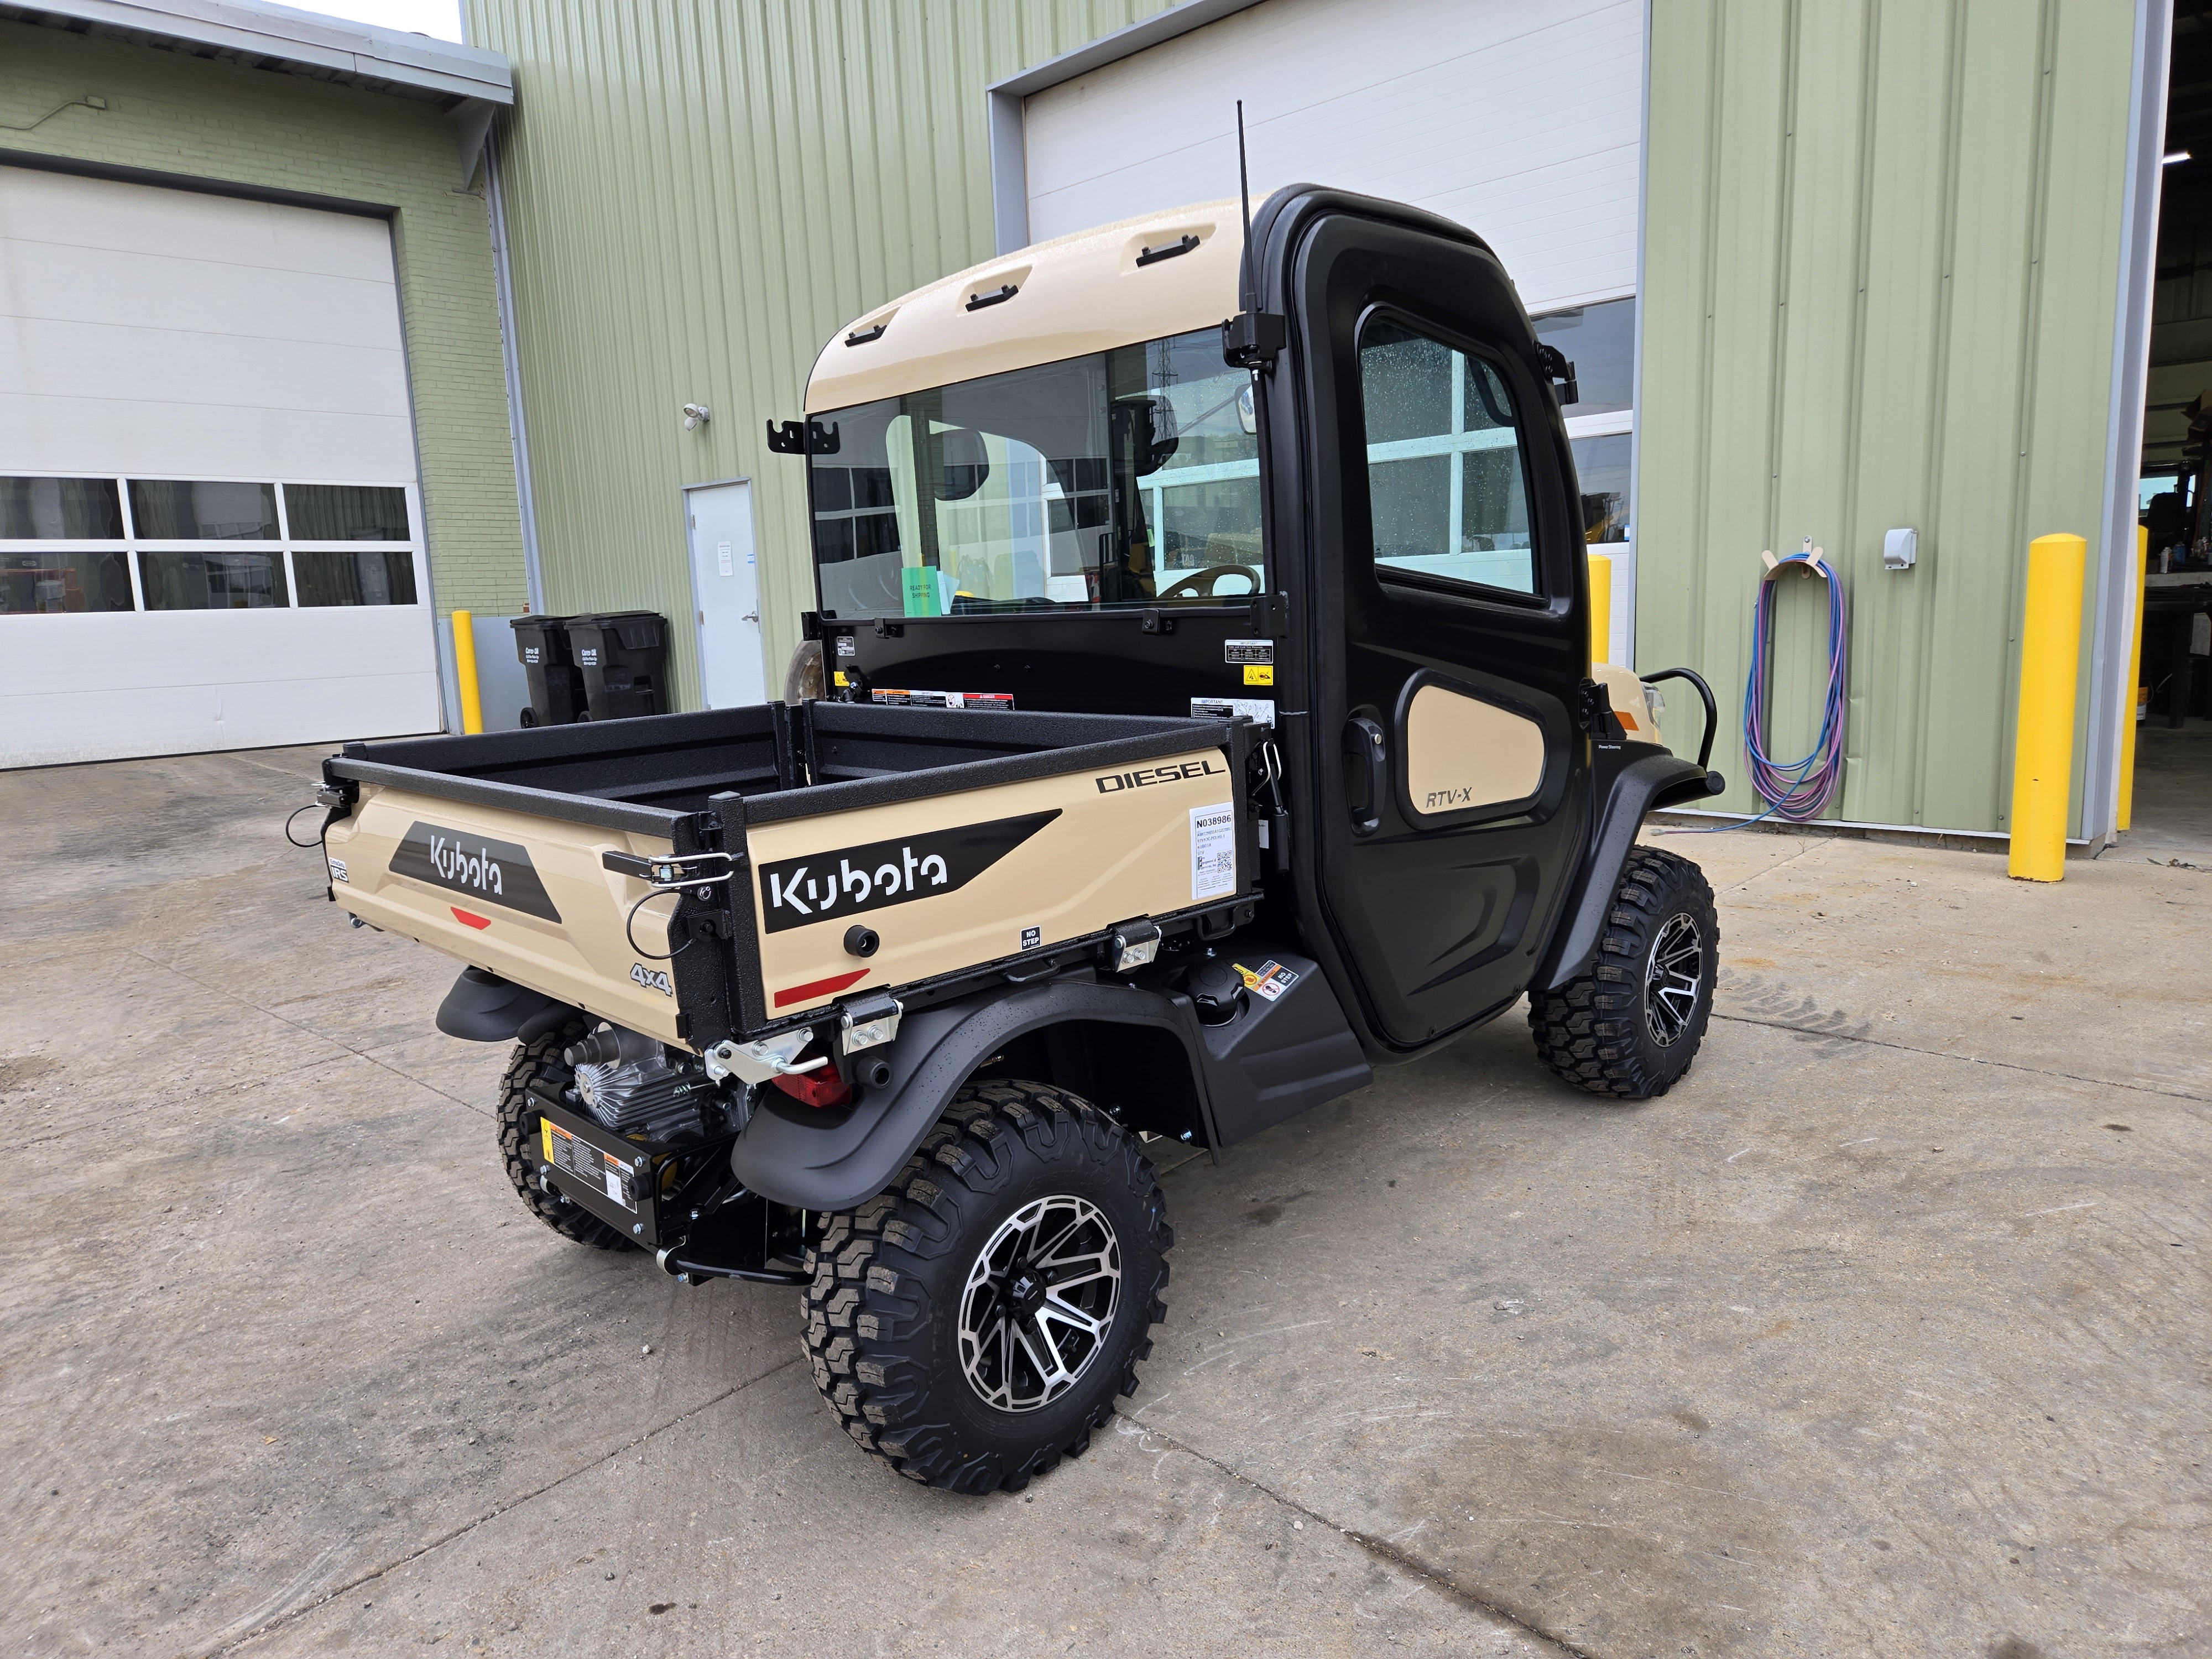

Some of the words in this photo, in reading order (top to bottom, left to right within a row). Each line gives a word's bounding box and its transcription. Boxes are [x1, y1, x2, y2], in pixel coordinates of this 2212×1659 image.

[1095, 760, 1226, 794] DIESEL
[1425, 787, 1472, 808] RTV-X
[1197, 815, 1232, 828] N038986
[331, 866, 348, 882] IRS
[430, 835, 503, 895] Kubota
[770, 847, 947, 915] Kubota
[1022, 937, 1040, 947] STEP
[1026, 930, 1036, 938] NO
[630, 962, 673, 998] 4x4
[1281, 973, 1292, 983] STEP
